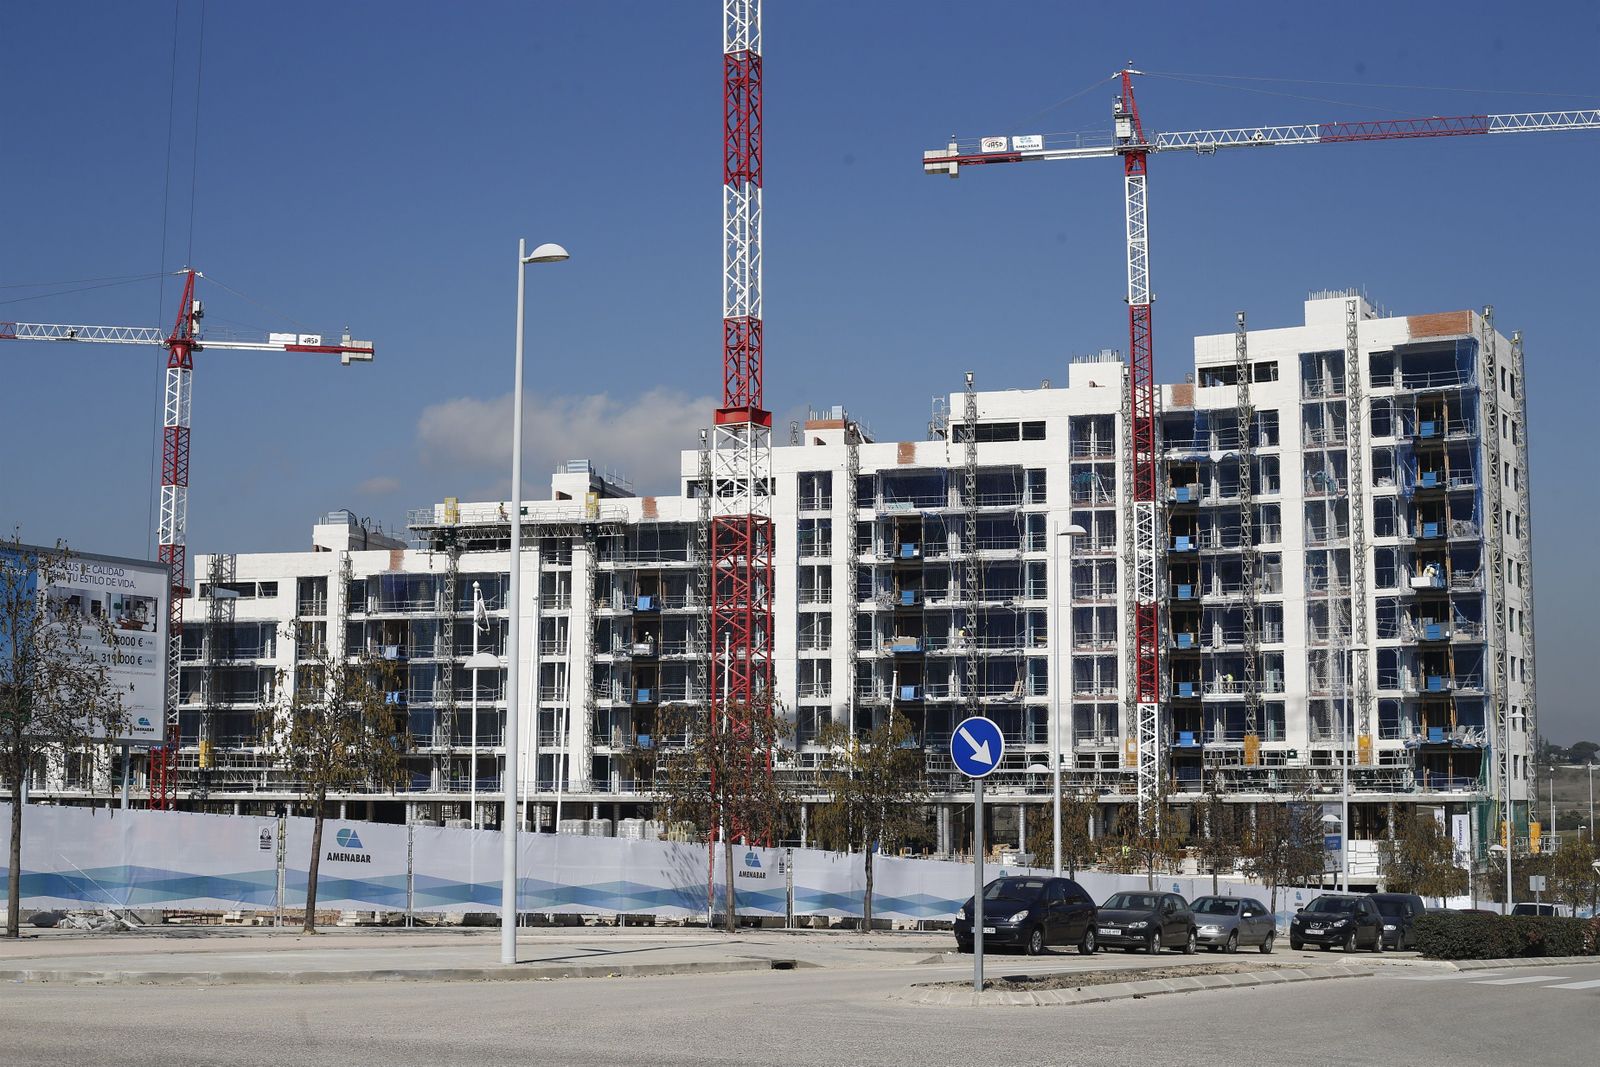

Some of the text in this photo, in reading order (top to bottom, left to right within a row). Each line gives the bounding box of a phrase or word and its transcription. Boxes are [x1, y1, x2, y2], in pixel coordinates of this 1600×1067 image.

[92, 564, 125, 577] CALIDAD
[67, 572, 78, 582] TU
[80, 574, 105, 585] ESTILO
[106, 577, 116, 586] DE
[117, 579, 137, 589] VIDA.
[326, 852, 371, 863] AMENABAR
[738, 870, 767, 879] AMENABAR
